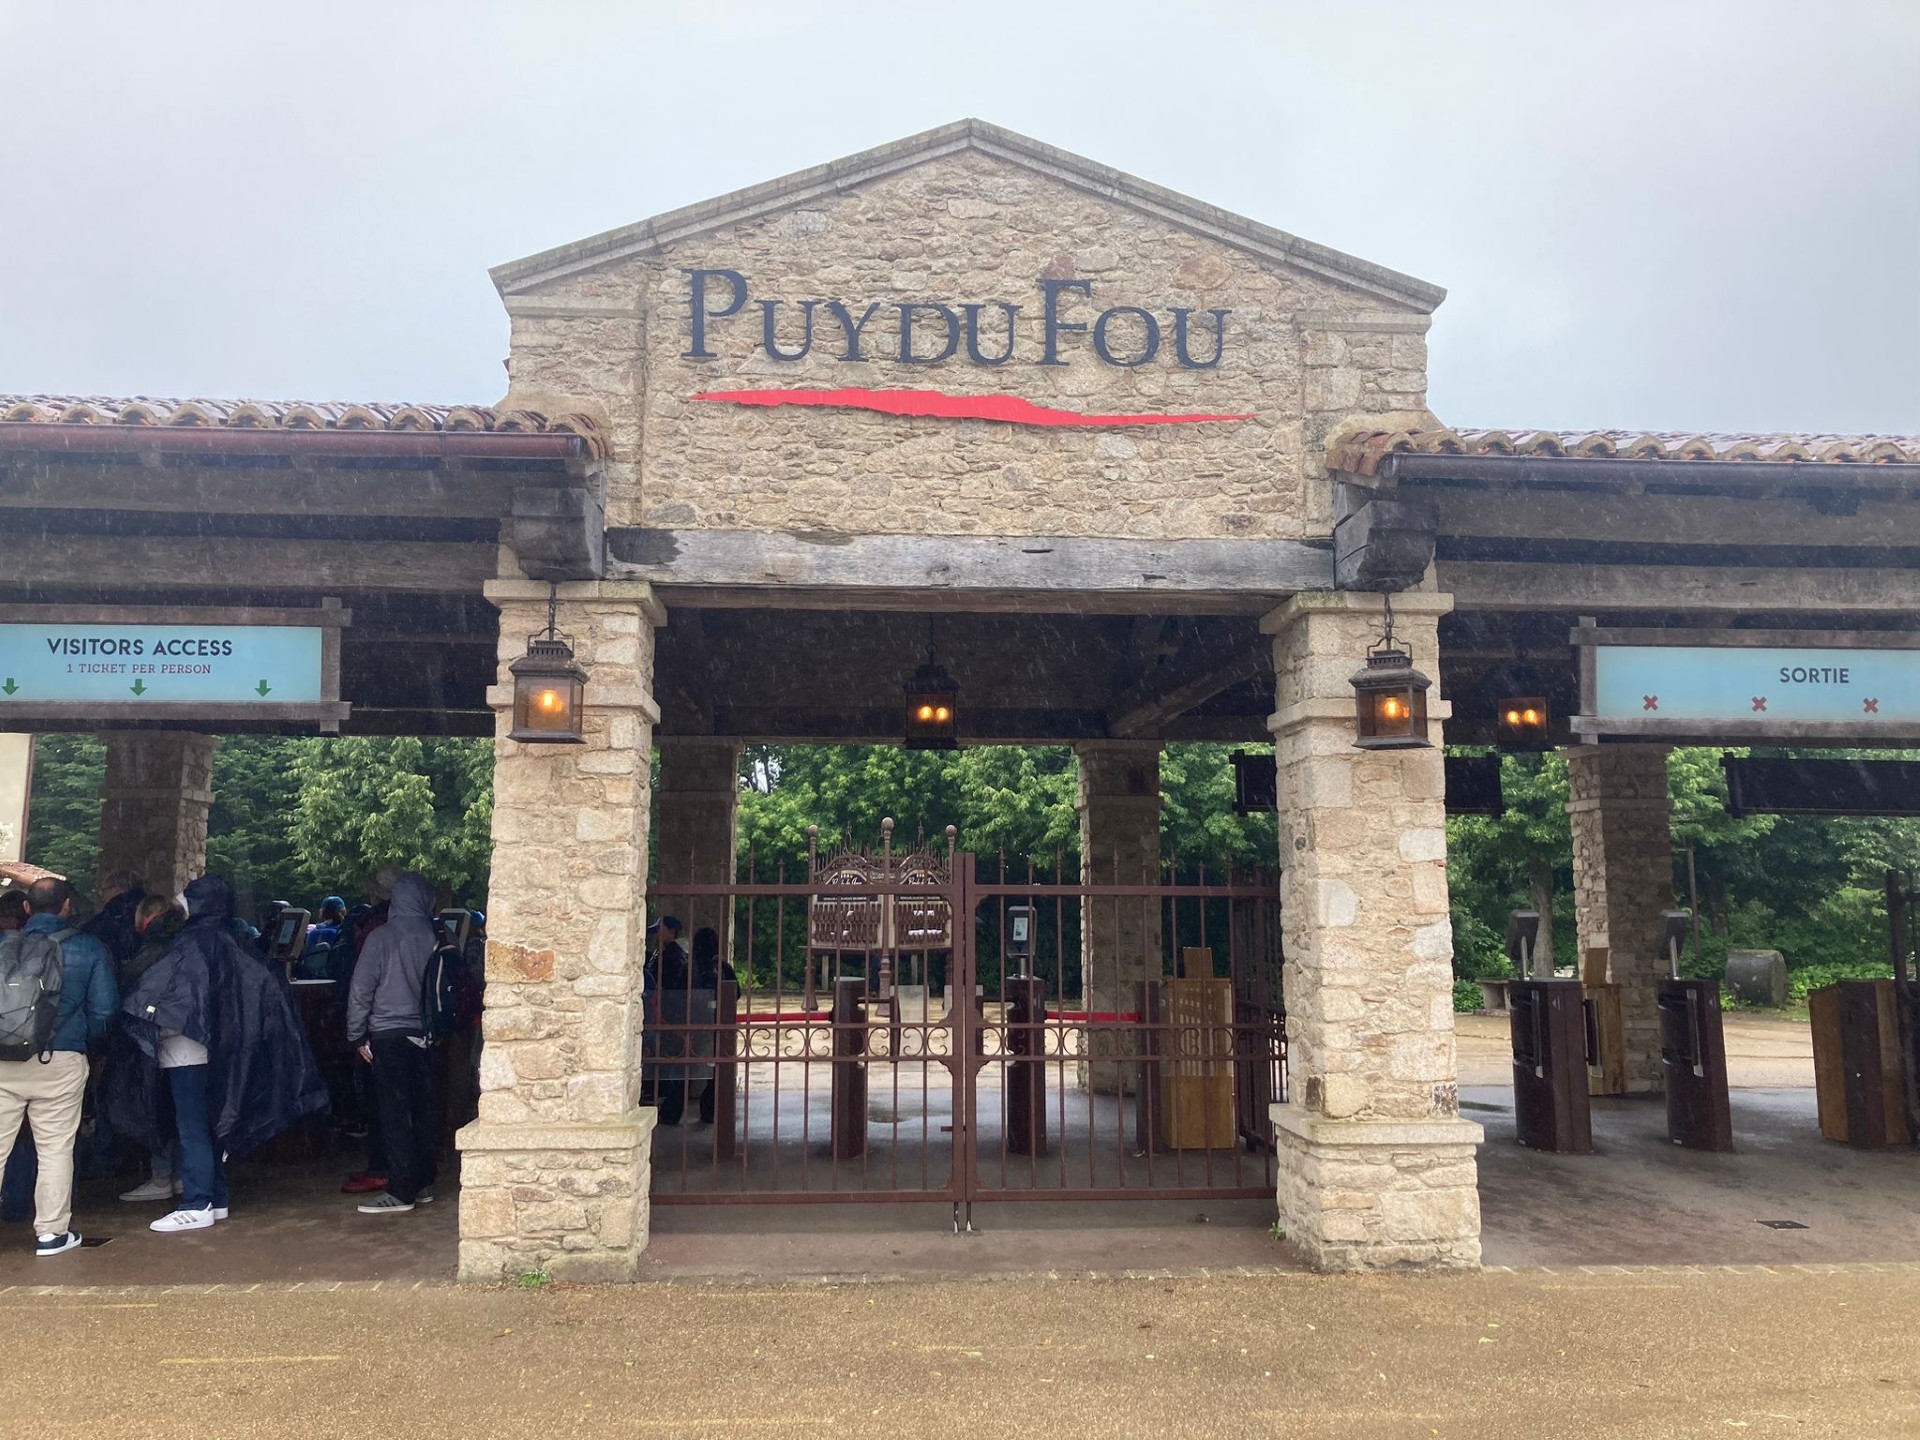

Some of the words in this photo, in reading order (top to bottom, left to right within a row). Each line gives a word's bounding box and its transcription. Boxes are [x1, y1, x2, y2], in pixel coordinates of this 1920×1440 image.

[47, 638, 144, 656] VISITORS
[153, 639, 233, 657] ACCESS
[67, 663, 73, 674] 1
[79, 664, 126, 674] TICKET
[132, 664, 156, 674] PER
[161, 664, 211, 675] PERSON
[1779, 667, 1850, 684] SORTIE
